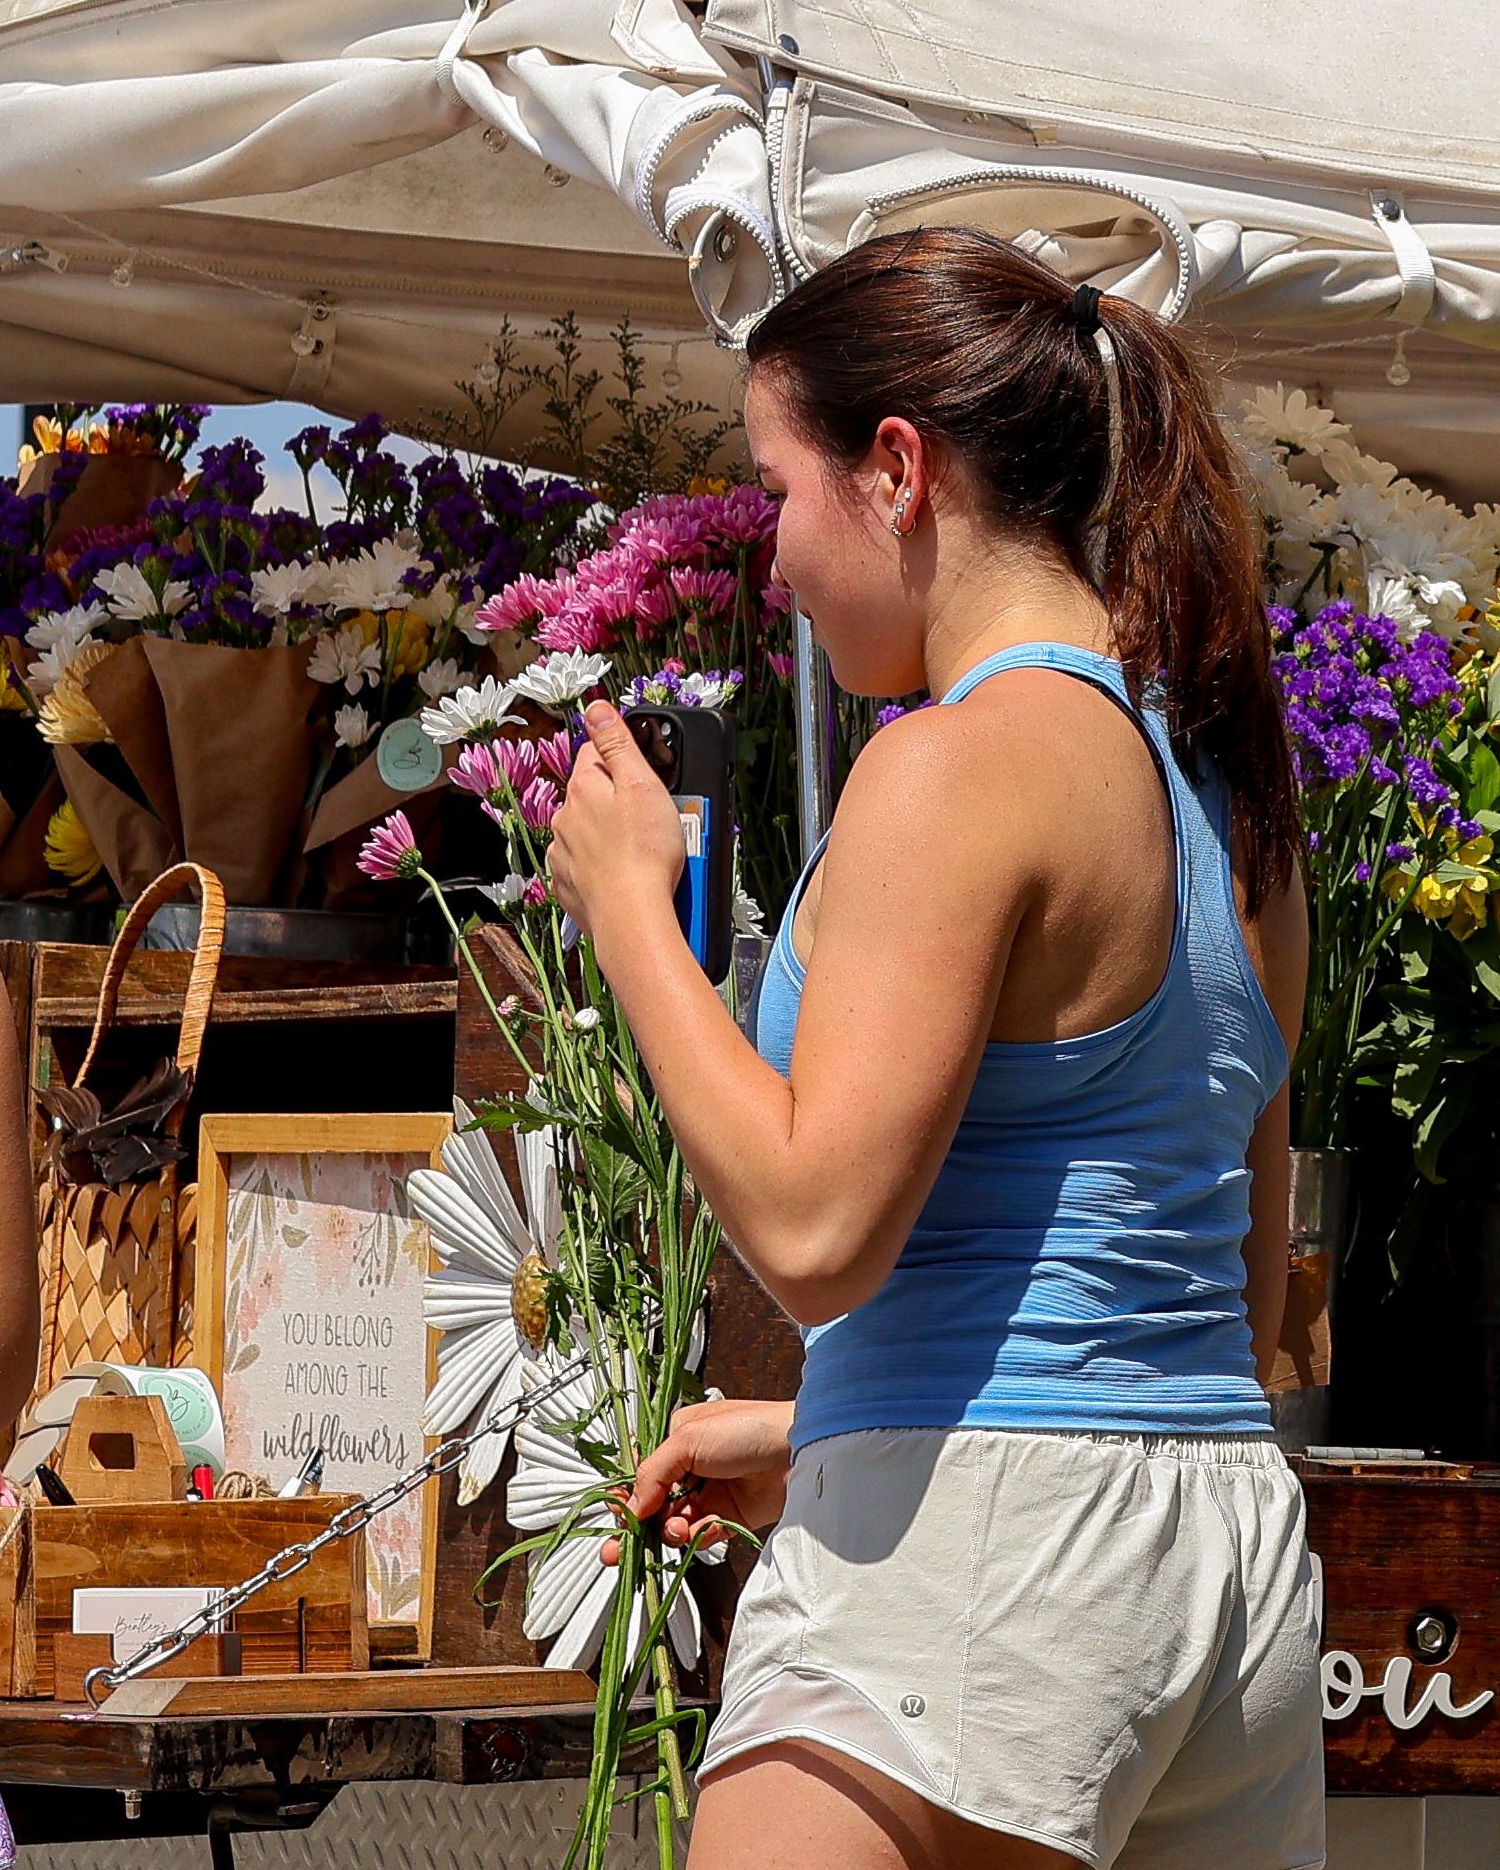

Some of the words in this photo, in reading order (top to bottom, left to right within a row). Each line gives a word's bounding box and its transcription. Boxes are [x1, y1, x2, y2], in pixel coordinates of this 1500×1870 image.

[283, 1312, 318, 1346] YOU
[325, 1313, 394, 1348] BELONG
[284, 1362, 349, 1396] AMONG
[357, 1364, 389, 1398] THE
[262, 1411, 410, 1471] wildflowers
[1310, 1551, 1495, 1730] ou
